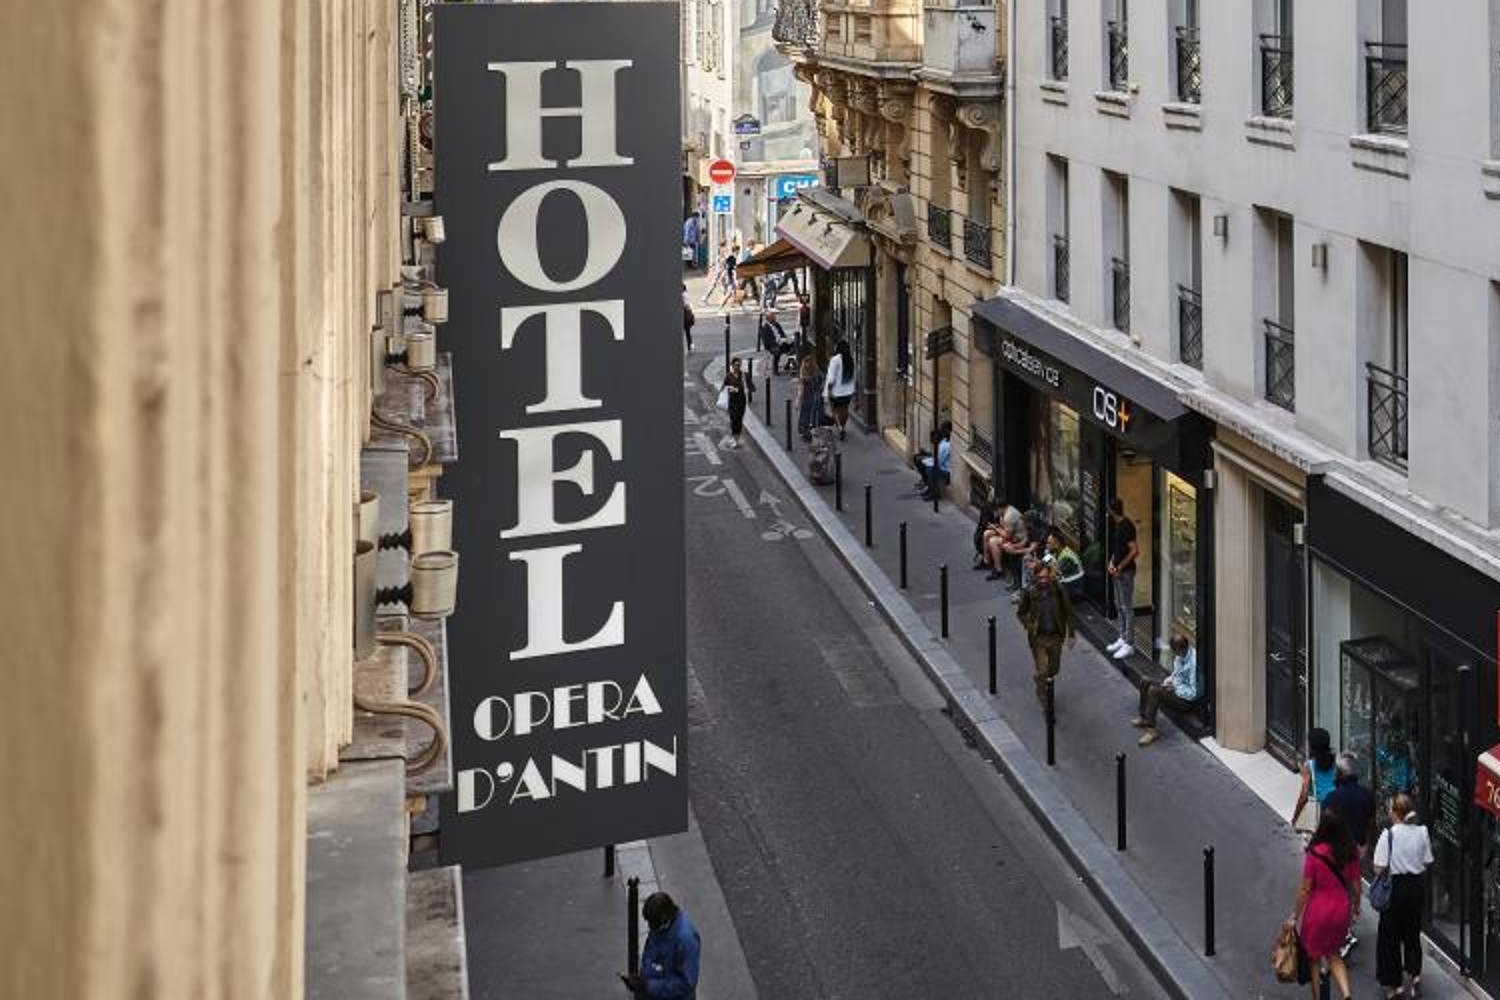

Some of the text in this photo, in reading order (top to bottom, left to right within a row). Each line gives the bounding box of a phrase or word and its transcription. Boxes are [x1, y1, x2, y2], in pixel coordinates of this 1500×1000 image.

[487, 58, 636, 661] HOTEL
[473, 673, 663, 741] OPERA
[456, 735, 677, 813] D'ANTIN
